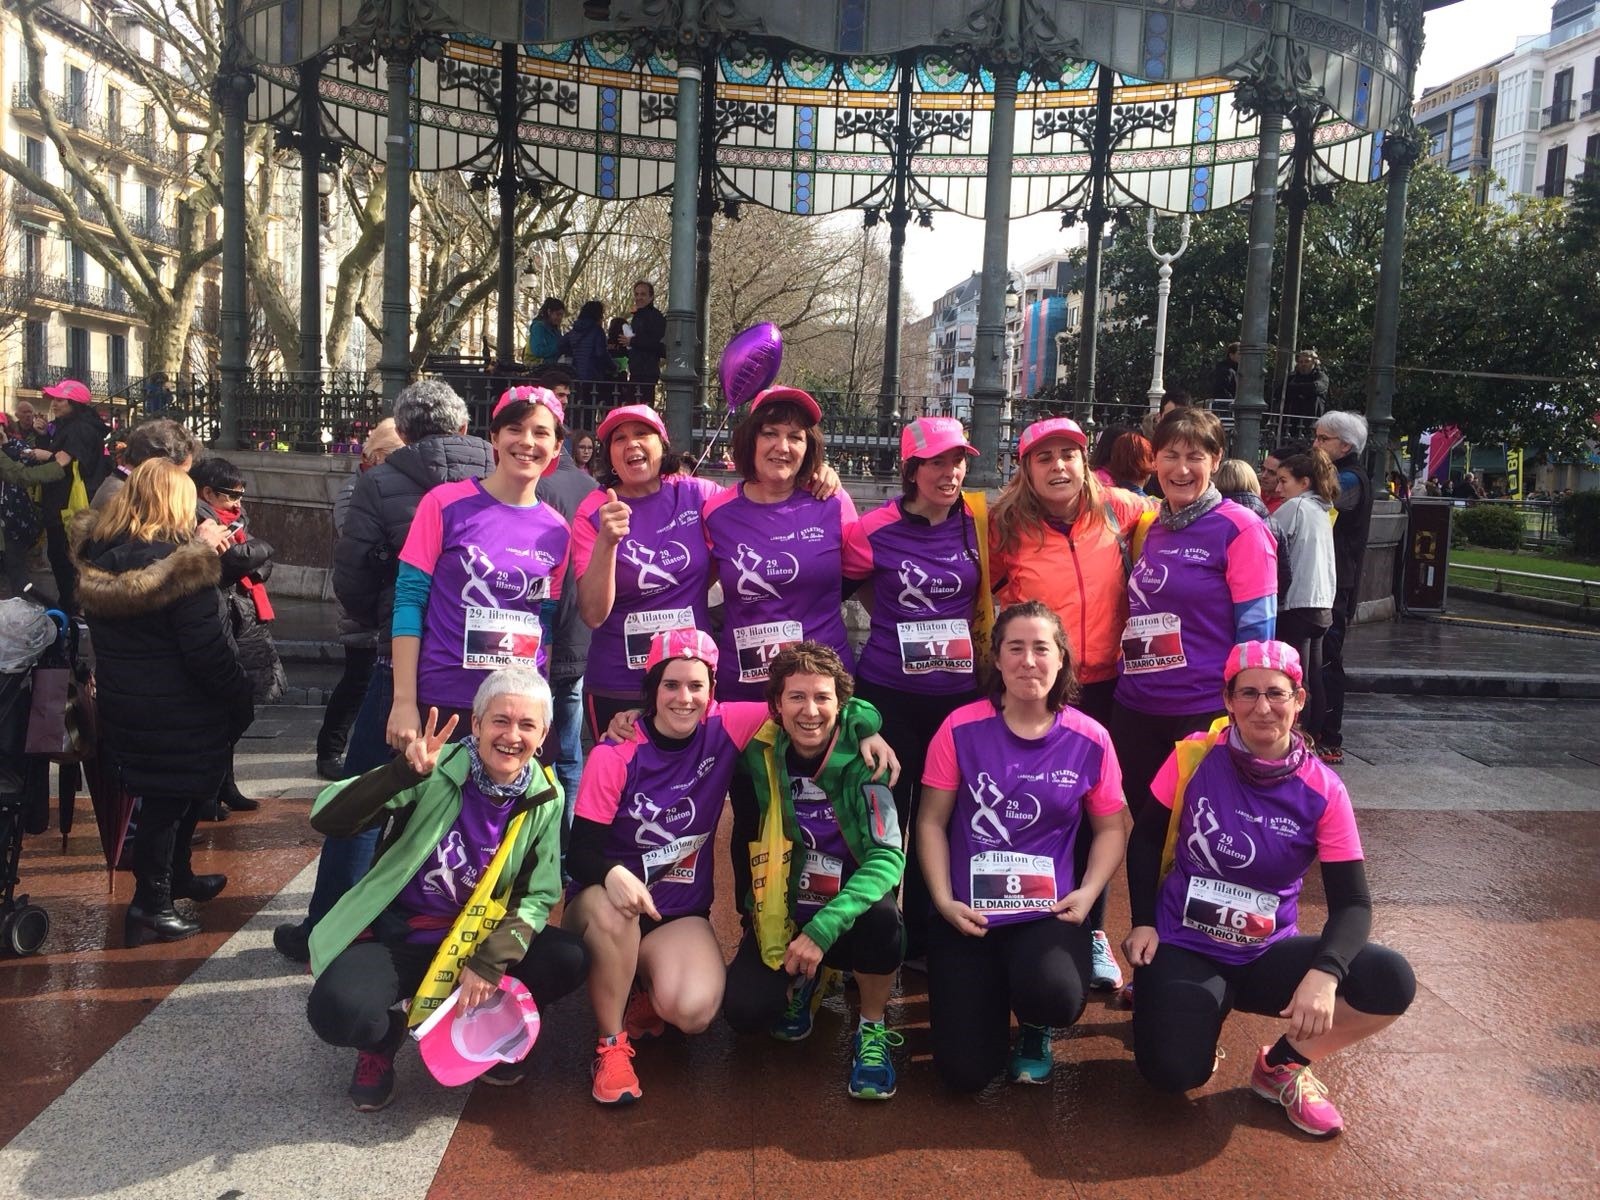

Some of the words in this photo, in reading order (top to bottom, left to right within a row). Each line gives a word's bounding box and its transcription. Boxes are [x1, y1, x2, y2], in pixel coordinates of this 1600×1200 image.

[662, 554, 686, 566] lilaton
[766, 567, 793, 576] lilaton
[495, 581, 521, 592] lilaton
[930, 586, 955, 594] lilaton
[469, 608, 485, 619] 29.
[488, 609, 521, 622] lilaton
[641, 612, 674, 623] lilaton
[900, 624, 914, 633] 29.
[916, 622, 947, 632] lilaton
[1130, 617, 1159, 627] lilaton
[749, 626, 779, 637] lilaton
[498, 631, 514, 652] 4
[1140, 636, 1154, 654] 7
[756, 643, 781, 662] 14
[924, 640, 950, 656] 17
[466, 655, 478, 663] EL
[479, 655, 511, 665] DIARIO
[630, 656, 640, 664] EL
[916, 660, 943, 670] DIARIO
[944, 660, 972, 668] VASCO
[1131, 659, 1155, 669] DIARIO
[1155, 655, 1185, 666] VASCO
[1006, 800, 1020, 811] 29.
[665, 809, 691, 824] lilaton
[1005, 809, 1034, 820] lilaton
[1218, 833, 1234, 847] 29.
[645, 851, 661, 862] 29.
[662, 840, 693, 855] lilaton
[1216, 843, 1247, 861] lilaton
[992, 853, 1028, 864] lilaton
[1006, 875, 1022, 894] 8
[1192, 878, 1210, 890] 29.
[1213, 882, 1252, 900] lilaton
[974, 900, 983, 909] EL
[986, 900, 1021, 909] DIARIO
[1022, 899, 1056, 908] VASCO
[1216, 906, 1248, 930] 16
[1197, 924, 1234, 940] DIARIO
[1235, 934, 1264, 944] VASC
